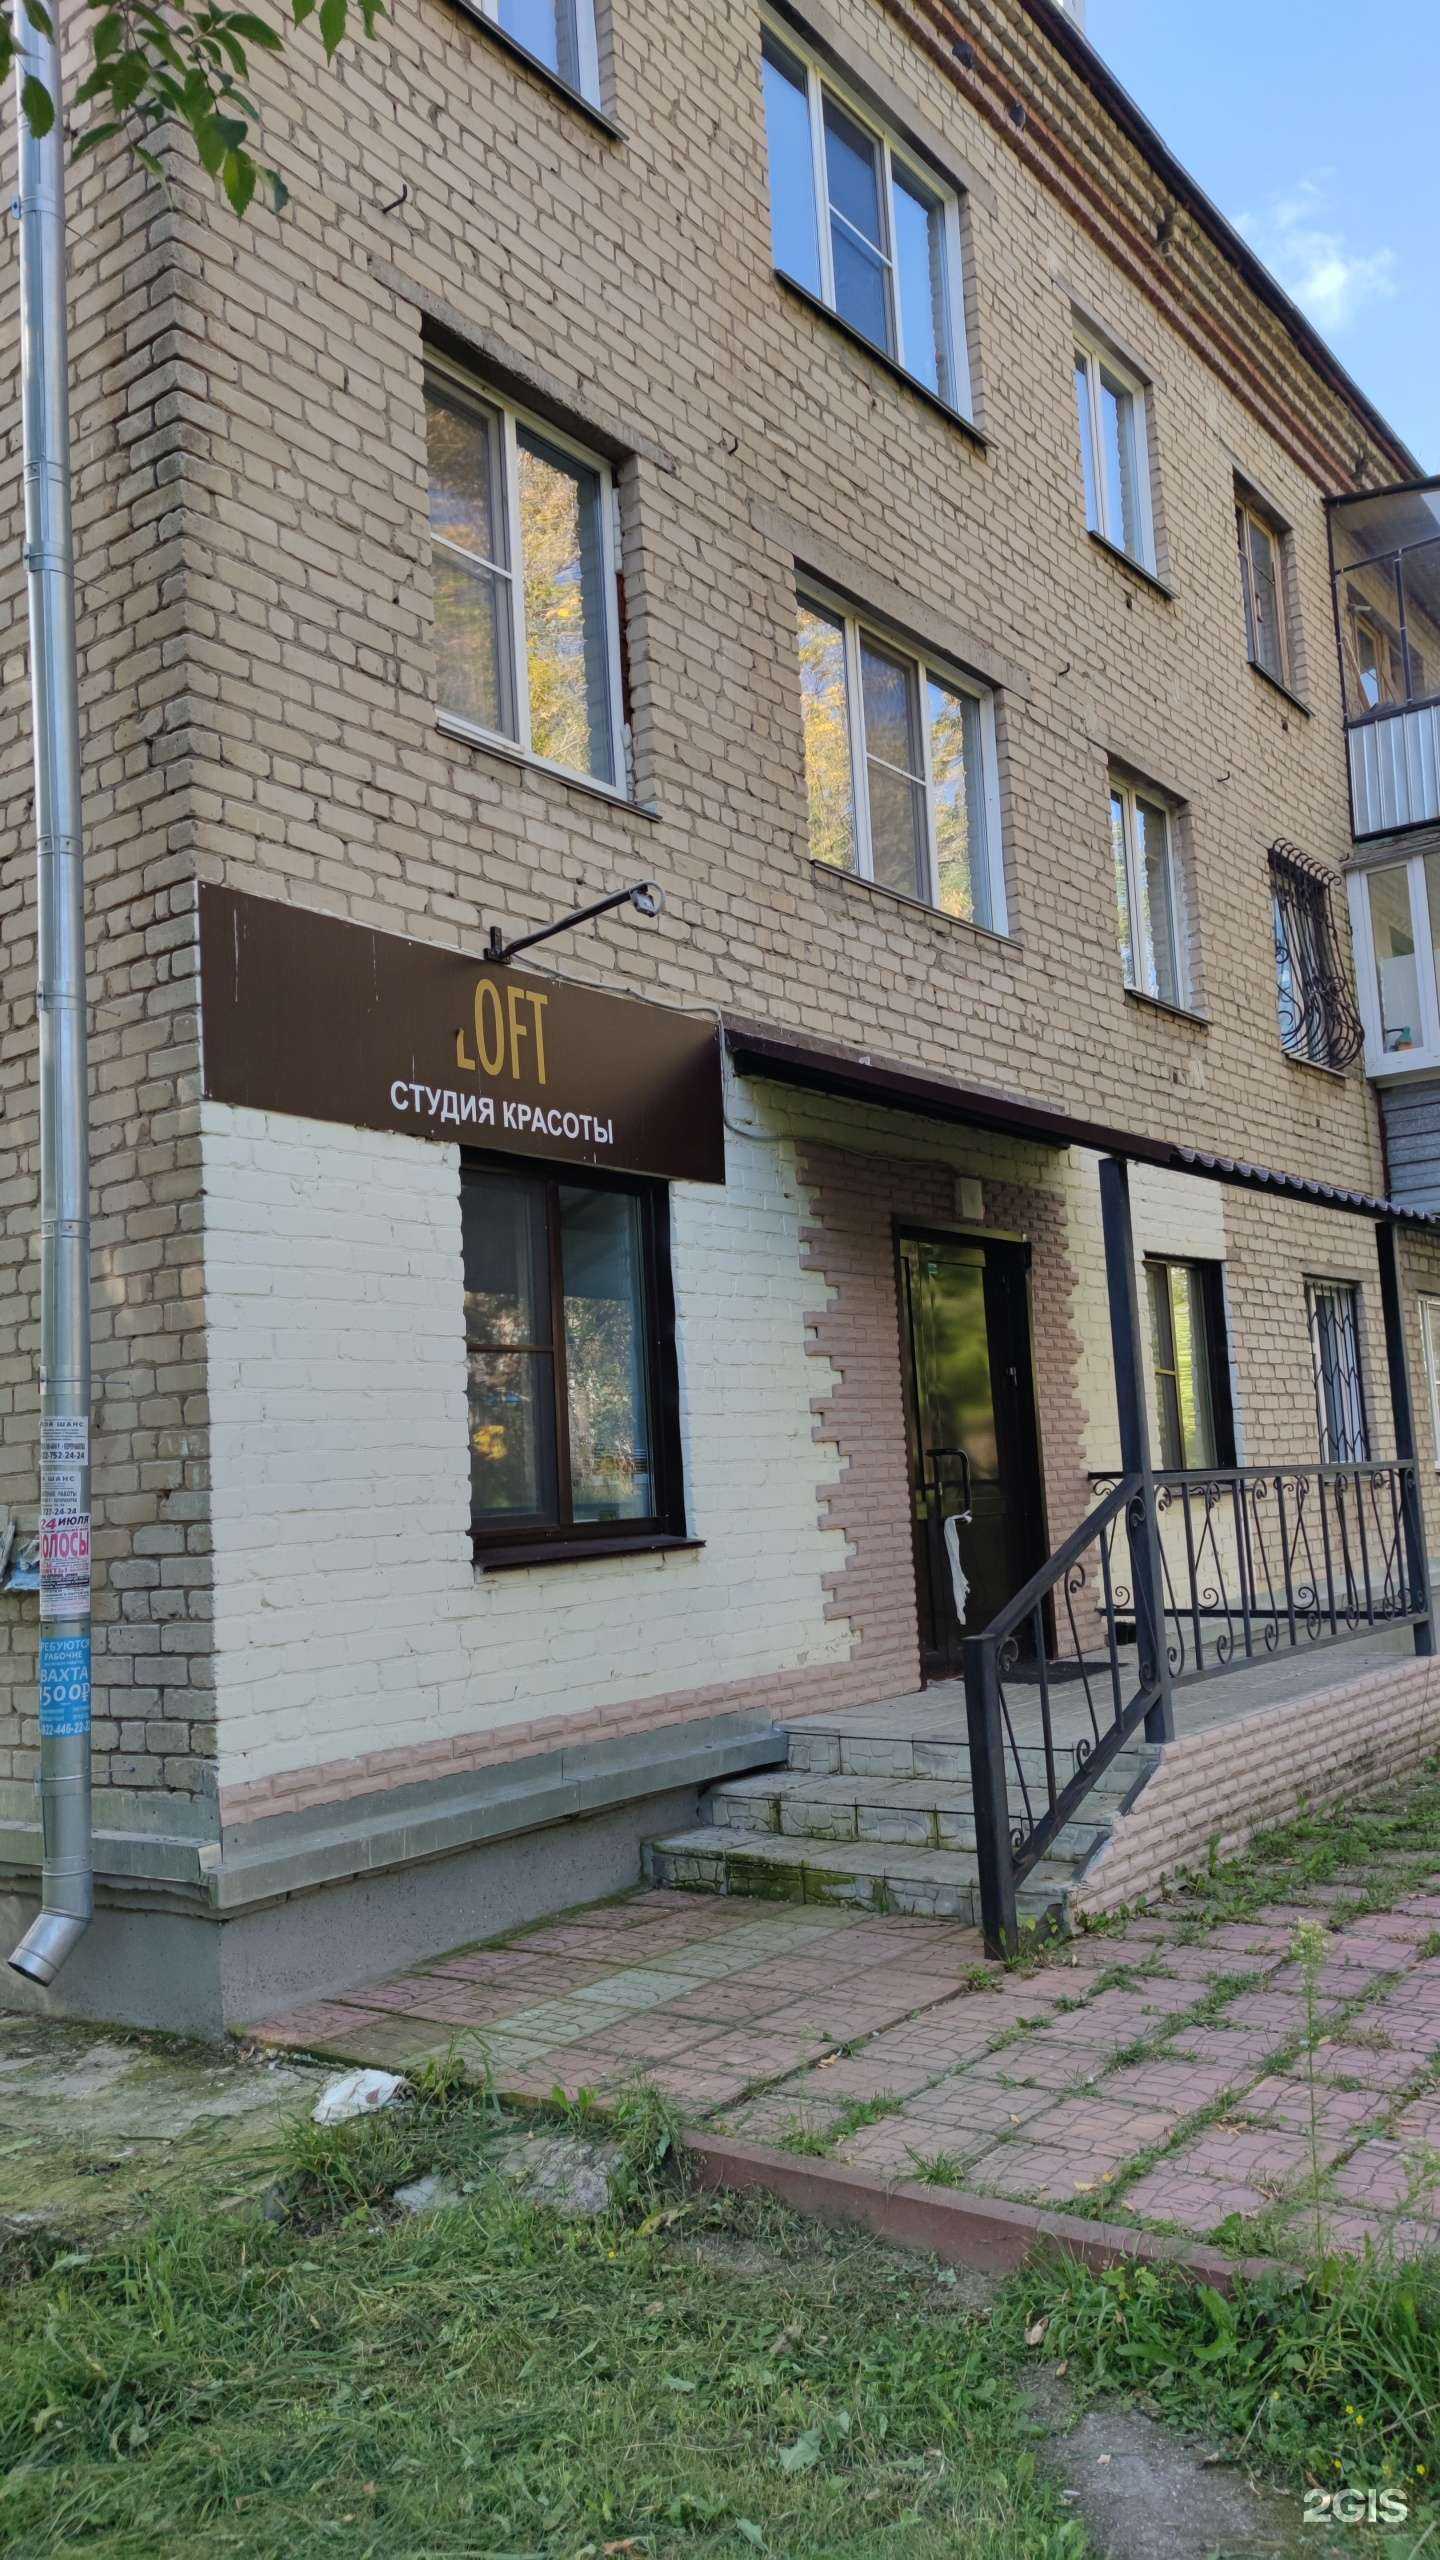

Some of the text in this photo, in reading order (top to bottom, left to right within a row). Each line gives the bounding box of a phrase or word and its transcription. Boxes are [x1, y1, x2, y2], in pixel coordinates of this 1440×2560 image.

[390, 1080, 614, 1145] СТУДИЯ КРАСОТЫ
[57, 1515, 90, 1526] ИЮЛЯ
[41, 1531, 90, 1559] ОЛОСЫ
[41, 1666, 88, 1682] ВАХТА
